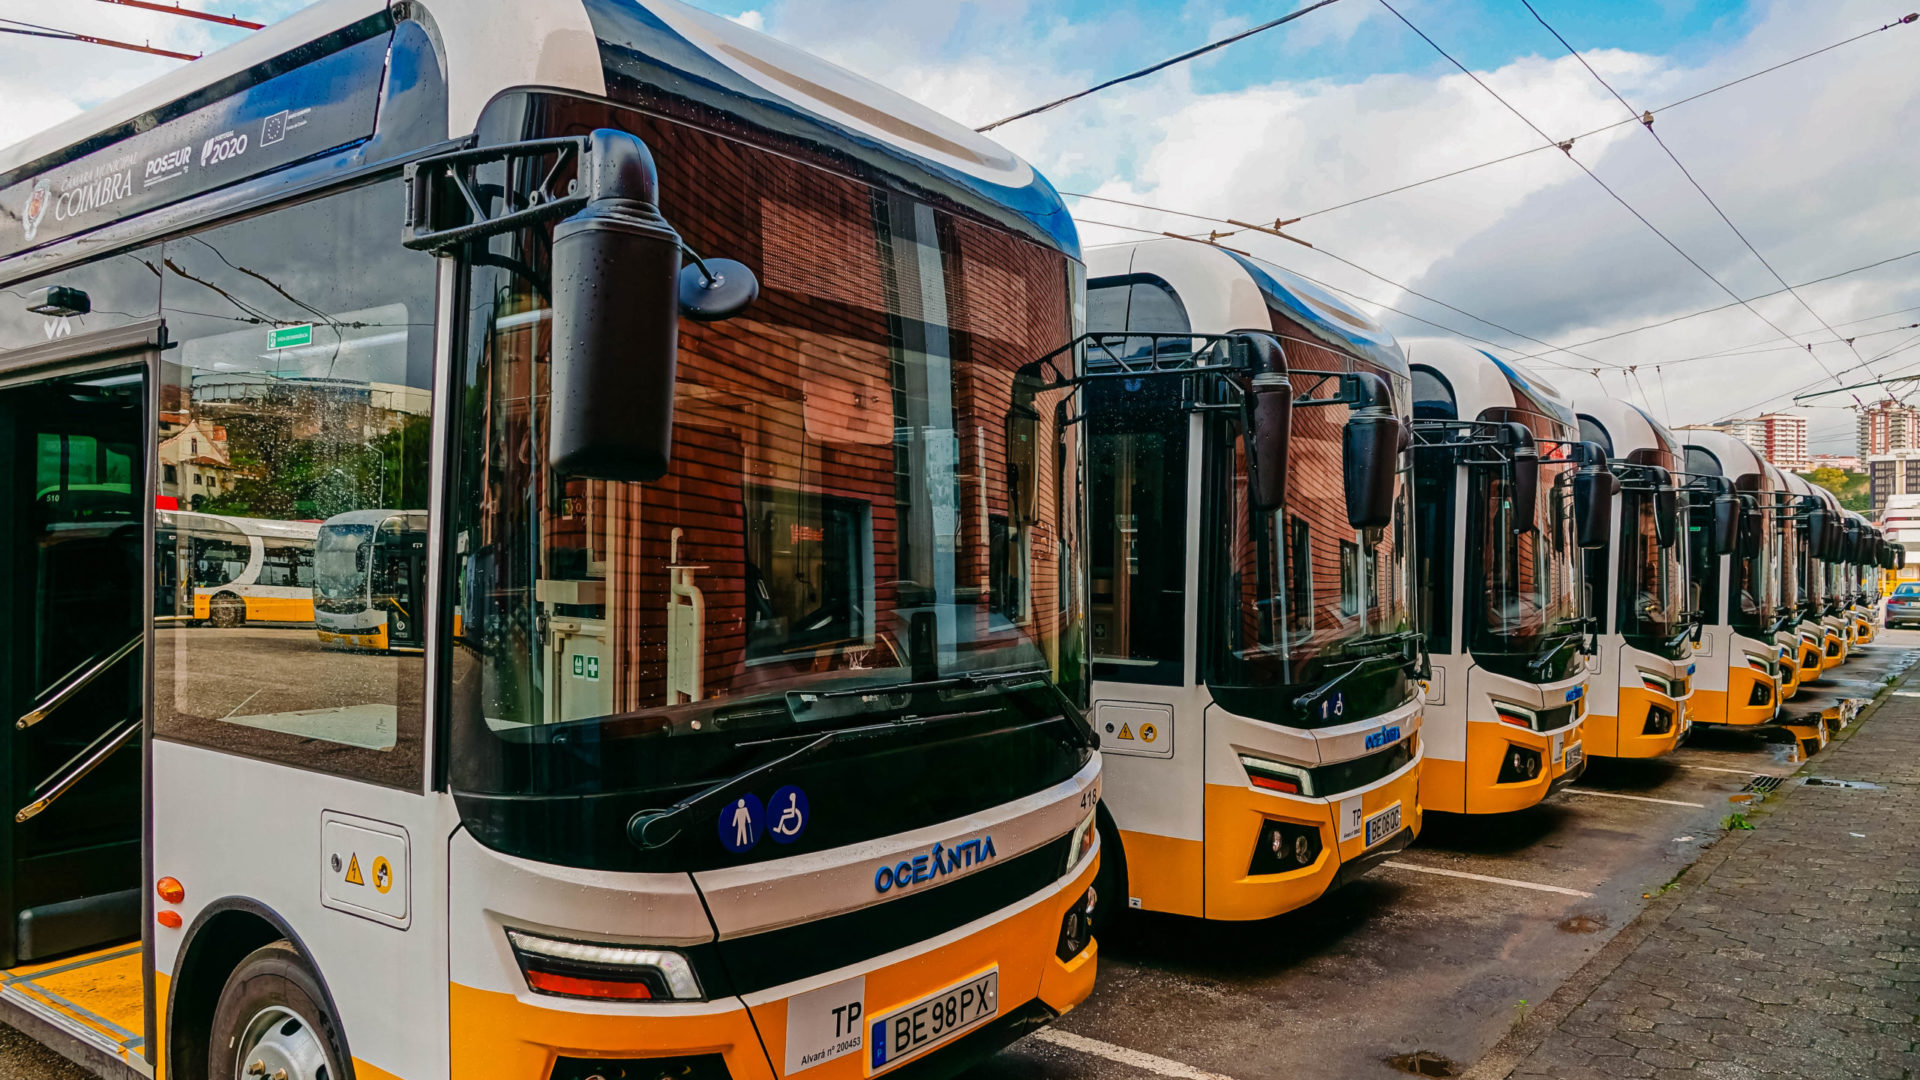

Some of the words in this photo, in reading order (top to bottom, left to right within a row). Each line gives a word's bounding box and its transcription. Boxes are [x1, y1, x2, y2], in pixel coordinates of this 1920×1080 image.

[145, 146, 192, 178] POSEUR
[210, 134, 248, 165] 2020
[55, 169, 132, 221] COIMBRA
[1080, 788, 1097, 810] 418
[1352, 808, 1361, 827] TP
[874, 835, 997, 893] OCEÂNTIA
[832, 1001, 862, 1038] TP
[801, 1048, 826, 1066] Alvará
[836, 1036, 861, 1053] 200453
